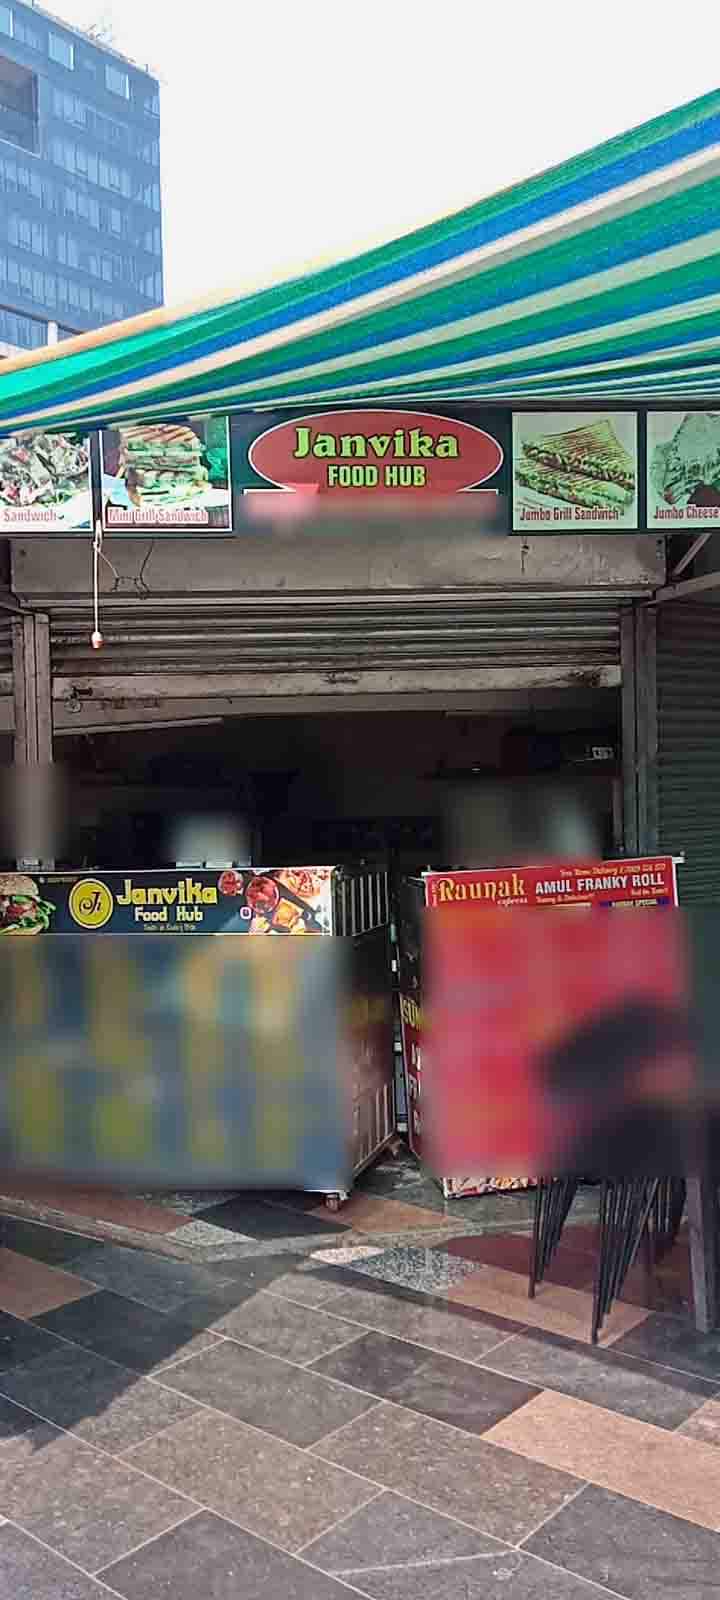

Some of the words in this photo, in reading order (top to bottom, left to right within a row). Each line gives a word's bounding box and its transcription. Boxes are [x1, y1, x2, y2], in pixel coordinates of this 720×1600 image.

[294, 427, 459, 458] Janvika
[327, 464, 380, 488] FOOD
[384, 464, 427, 488] HUB
[3, 509, 57, 522] Sandwich
[158, 509, 208, 523] Sandwich
[519, 508, 551, 521] Jumbo
[553, 507, 573, 520] Grill
[575, 506, 620, 521] Sandwich
[654, 506, 685, 519] Jumbo
[686, 505, 720, 519] Cheese
[117, 878, 217, 904] Janvika
[438, 873, 525, 902] Raunak
[535, 880, 572, 894] AMUL
[577, 875, 628, 891] FRANKY
[632, 872, 665, 887] ROLL
[134, 907, 168, 921] Food
[175, 906, 204, 921] Hub
